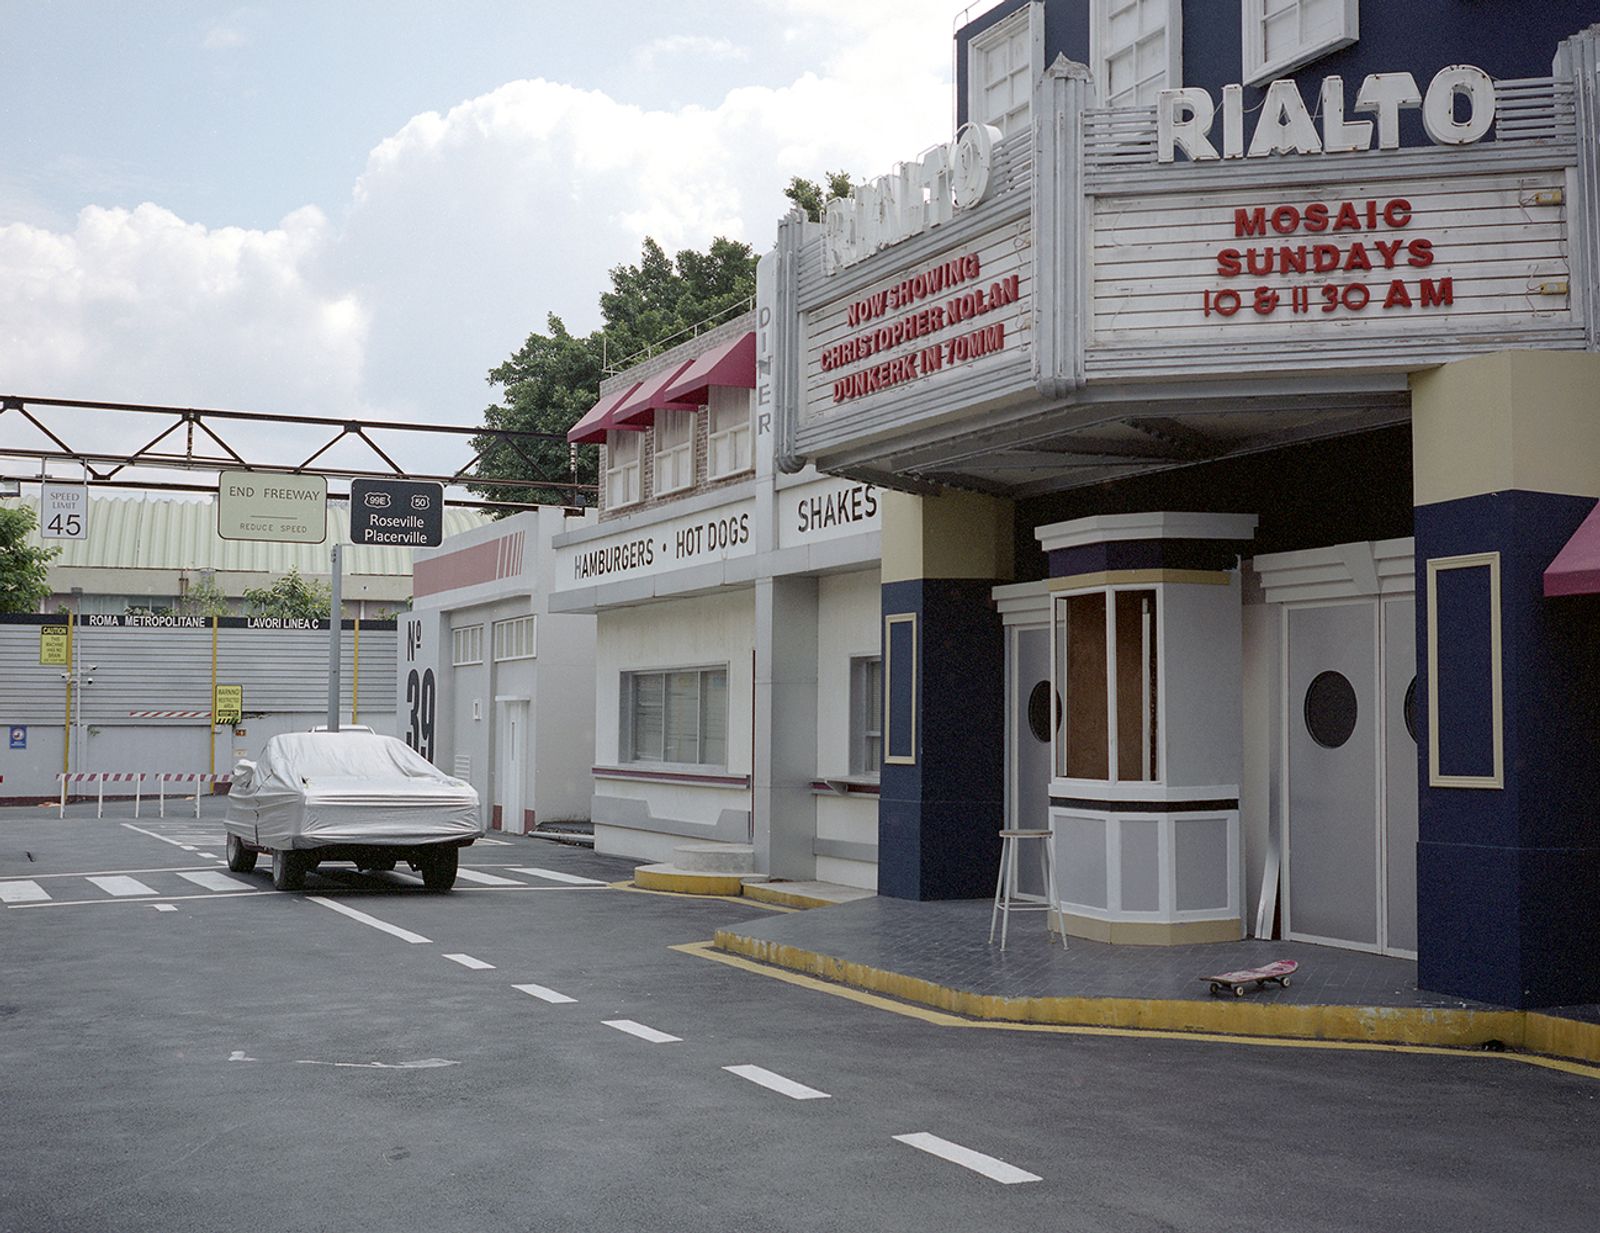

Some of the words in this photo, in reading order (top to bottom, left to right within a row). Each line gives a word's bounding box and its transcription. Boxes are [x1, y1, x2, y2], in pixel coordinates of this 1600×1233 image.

[1157, 64, 1496, 163] RIALTO
[1235, 197, 1413, 237] MOSAIC
[1216, 238, 1436, 278] SUNDAYS
[846, 289, 889, 327] NOW
[886, 252, 981, 311] SHOWING
[1203, 287, 1242, 317] 10
[1253, 285, 1280, 315] &
[1384, 276, 1455, 309] AM
[820, 305, 944, 372] CHRISTOPHER
[946, 274, 1020, 327] NOLAN
[758, 306, 773, 436] DINER
[833, 353, 918, 403] DUNKERK
[920, 345, 942, 375] IN
[946, 322, 1005, 365] 70MM
[50, 492, 80, 501] SPEED
[52, 502, 76, 510] LIMIT
[229, 486, 254, 497] END
[263, 488, 320, 500] FREEWAY
[369, 496, 386, 505] 99E
[415, 498, 426, 507] 50
[797, 484, 878, 533] SHAKES
[47, 513, 81, 536] 45
[240, 523, 273, 532] REDUCE
[280, 525, 307, 533] SPEED
[364, 528, 427, 544] Placerville
[369, 513, 424, 528] Roseville
[573, 537, 654, 581] HAMBURGERS
[675, 524, 704, 559] HOT
[707, 512, 750, 550] DOGS
[89, 615, 119, 627] ROMA
[124, 616, 205, 628] METROPOLITANE
[247, 618, 282, 629] LAVORI
[283, 619, 310, 630] LINEA
[311, 619, 319, 629] C
[406, 667, 436, 764] 39
